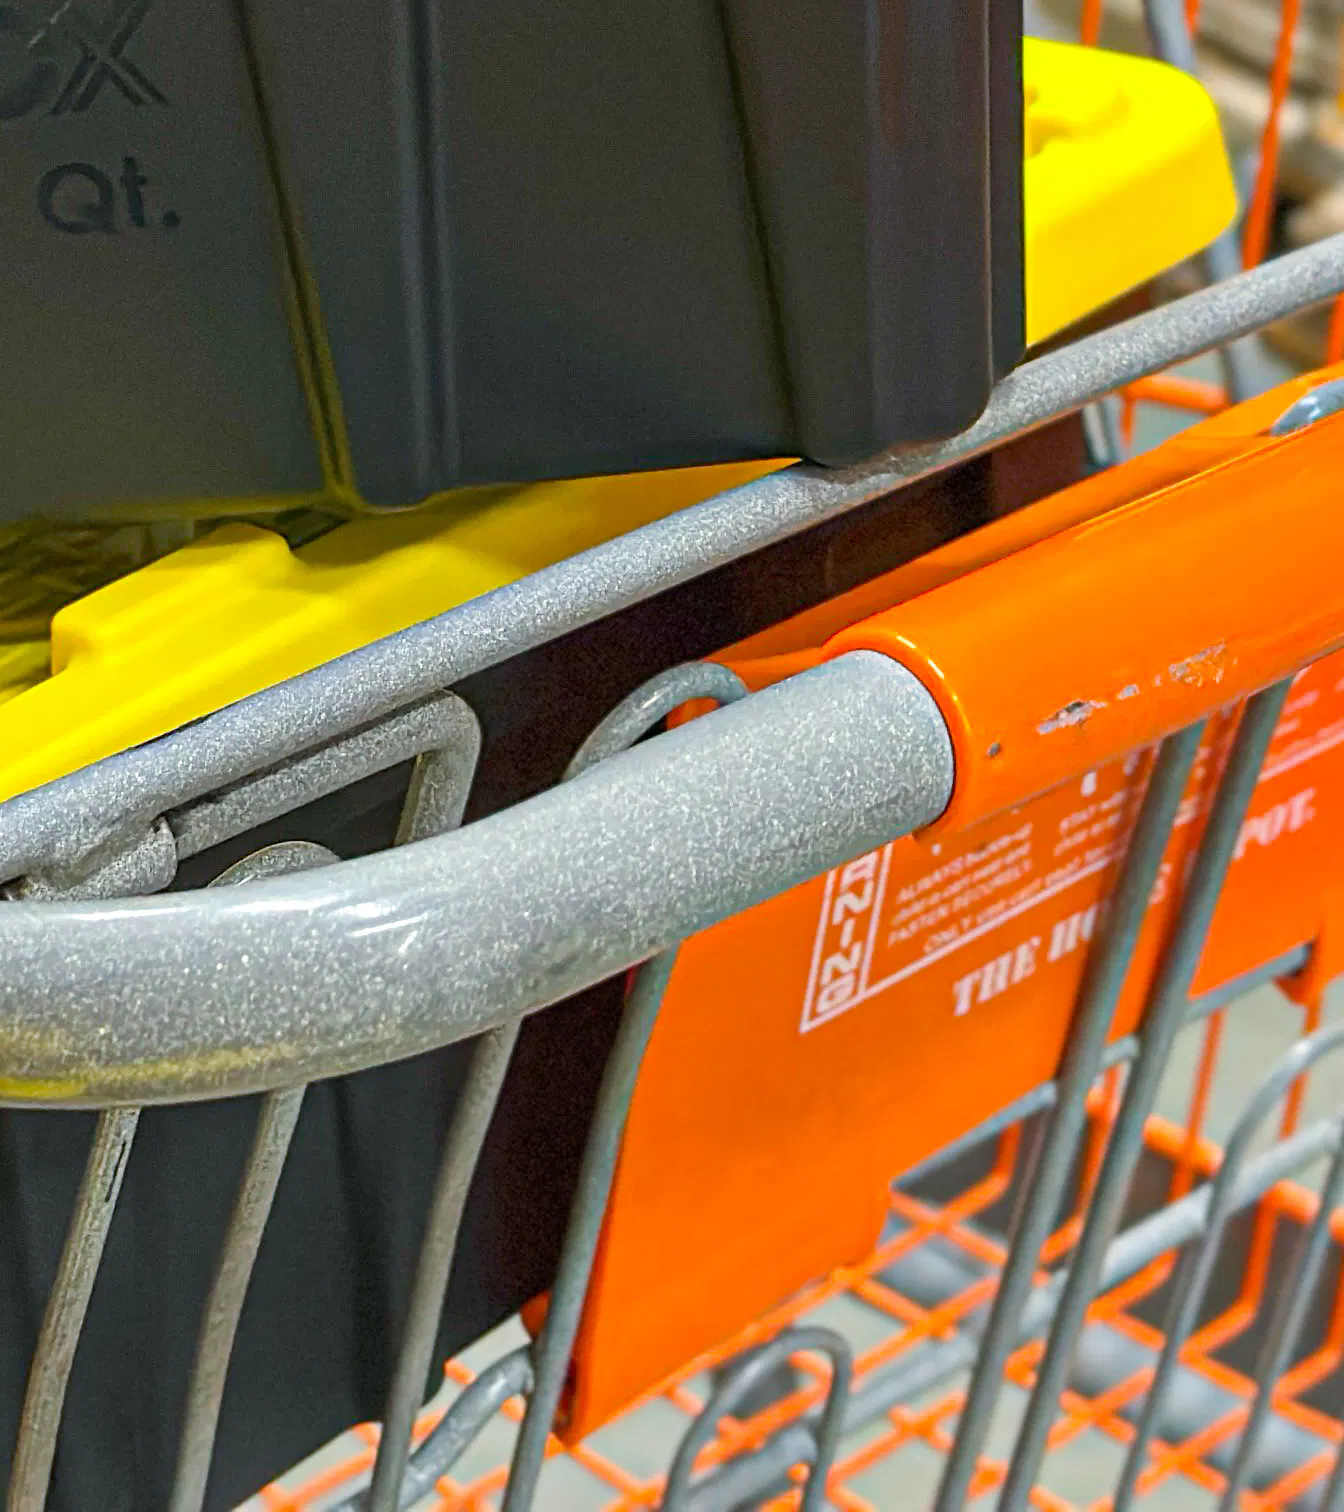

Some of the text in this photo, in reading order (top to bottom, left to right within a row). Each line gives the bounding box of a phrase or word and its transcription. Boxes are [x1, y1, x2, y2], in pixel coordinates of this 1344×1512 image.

[37, 154, 182, 237] Qt.
[815, 850, 880, 1015] RNING
[952, 933, 1042, 1018] THE
